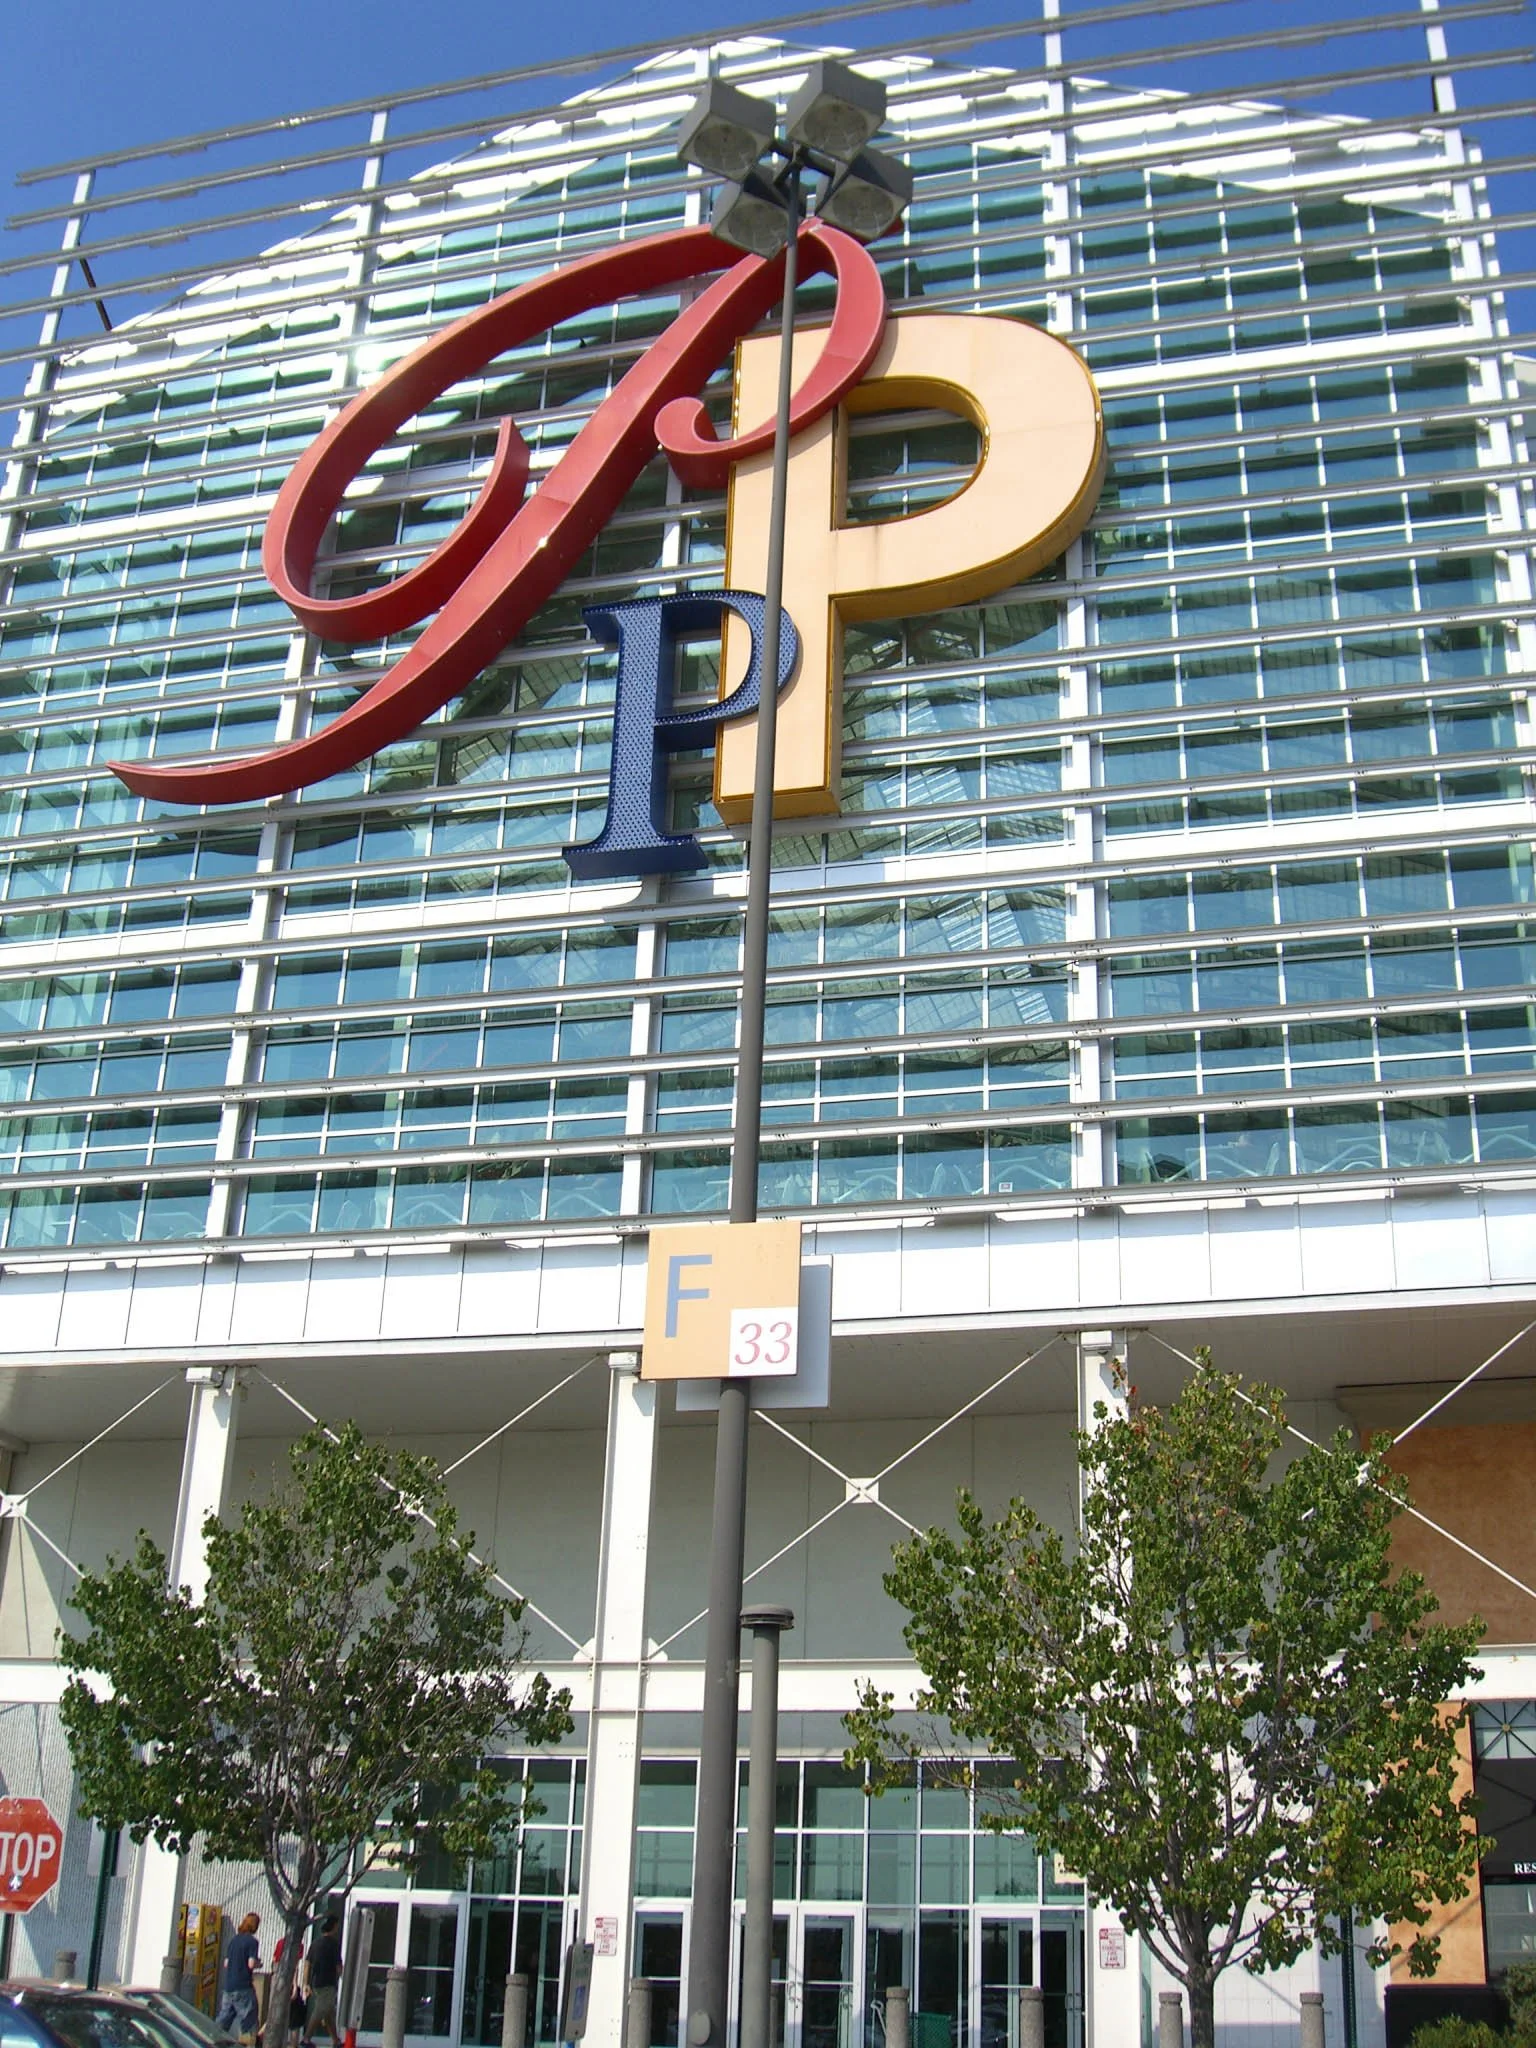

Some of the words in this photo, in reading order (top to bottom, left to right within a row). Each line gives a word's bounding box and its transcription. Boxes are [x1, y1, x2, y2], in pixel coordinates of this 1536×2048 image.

[713, 312, 1107, 826] P
[562, 590, 800, 881] P
[665, 1254, 713, 1338] F
[734, 1321, 792, 1365] 33
